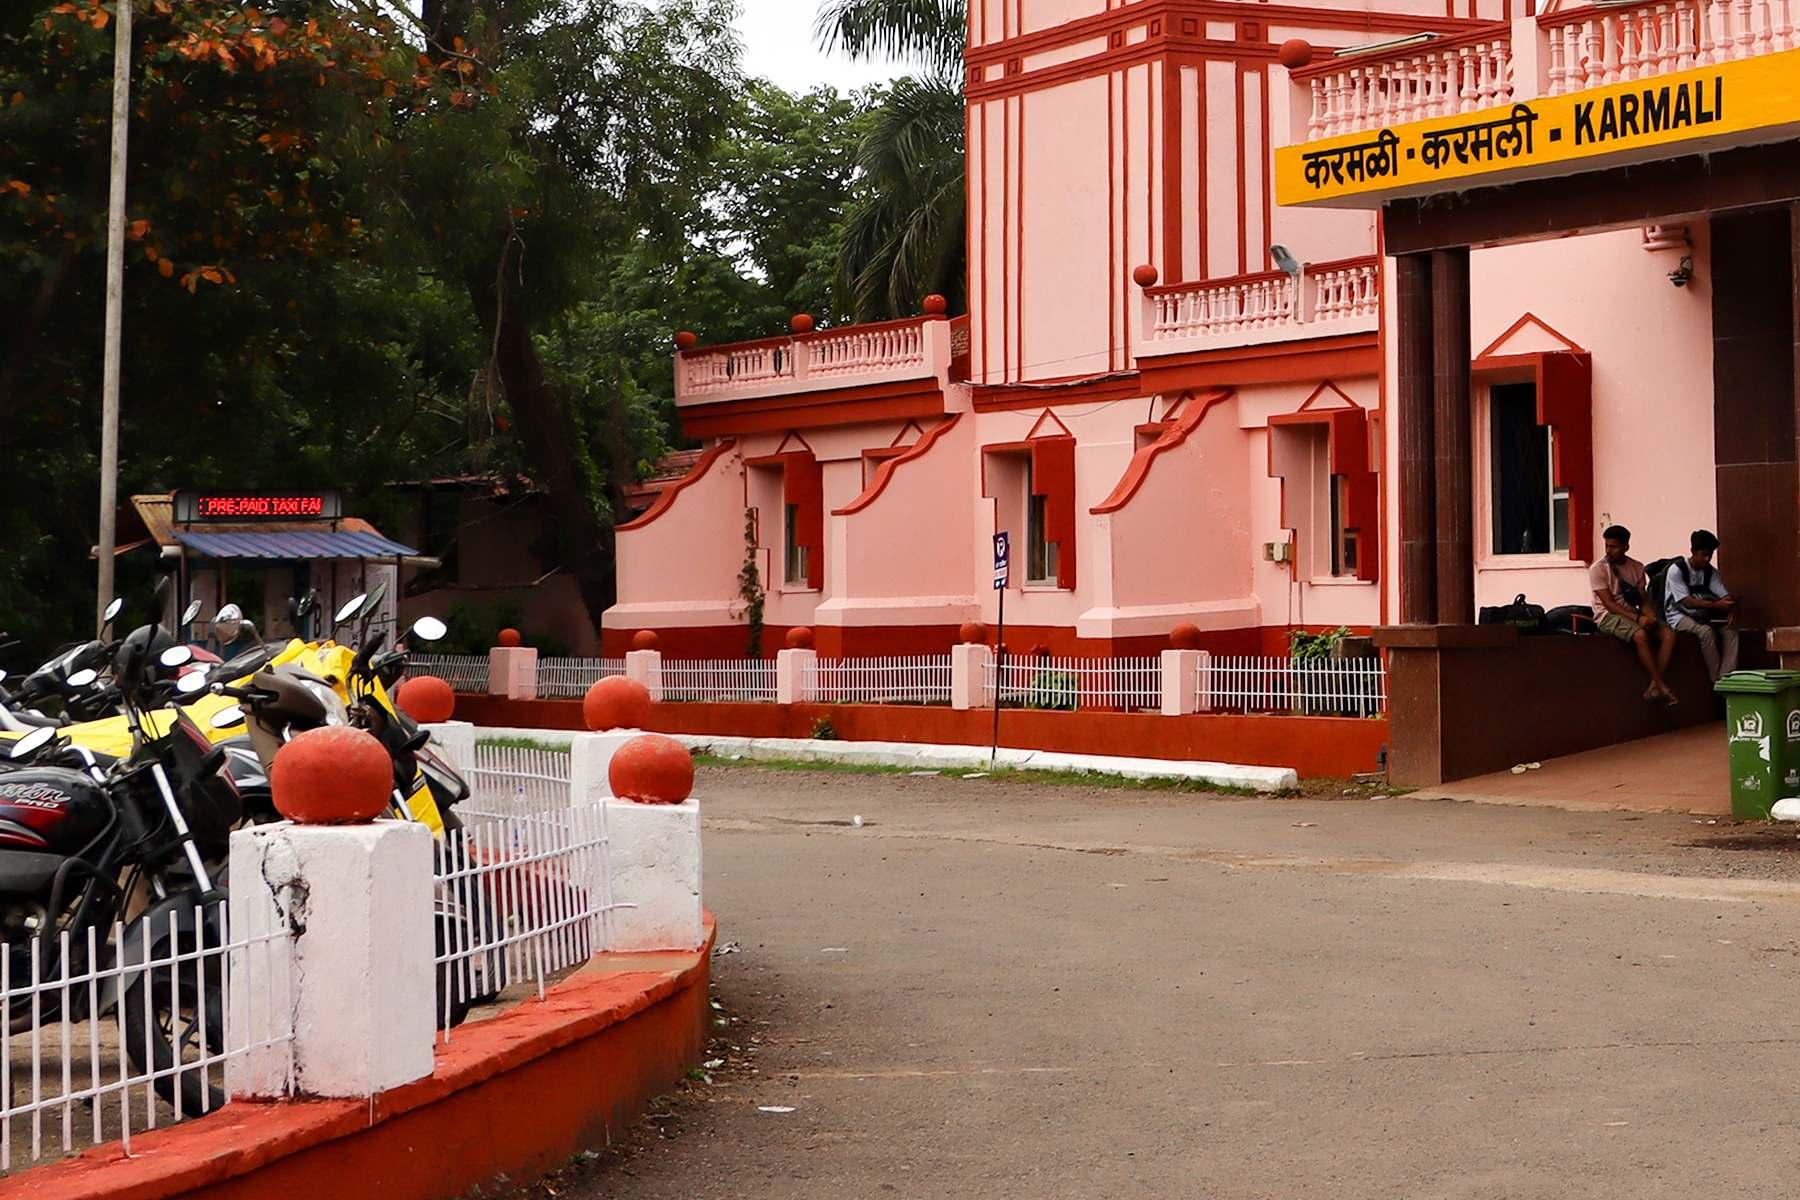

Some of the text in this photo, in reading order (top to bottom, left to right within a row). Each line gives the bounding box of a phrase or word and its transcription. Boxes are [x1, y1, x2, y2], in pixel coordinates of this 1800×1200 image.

[1574, 76, 1722, 145] KARMALI
[1302, 104, 1538, 188] करमळी करमली
[208, 501, 267, 512] PRE-PAID
[272, 501, 297, 512] TAXI
